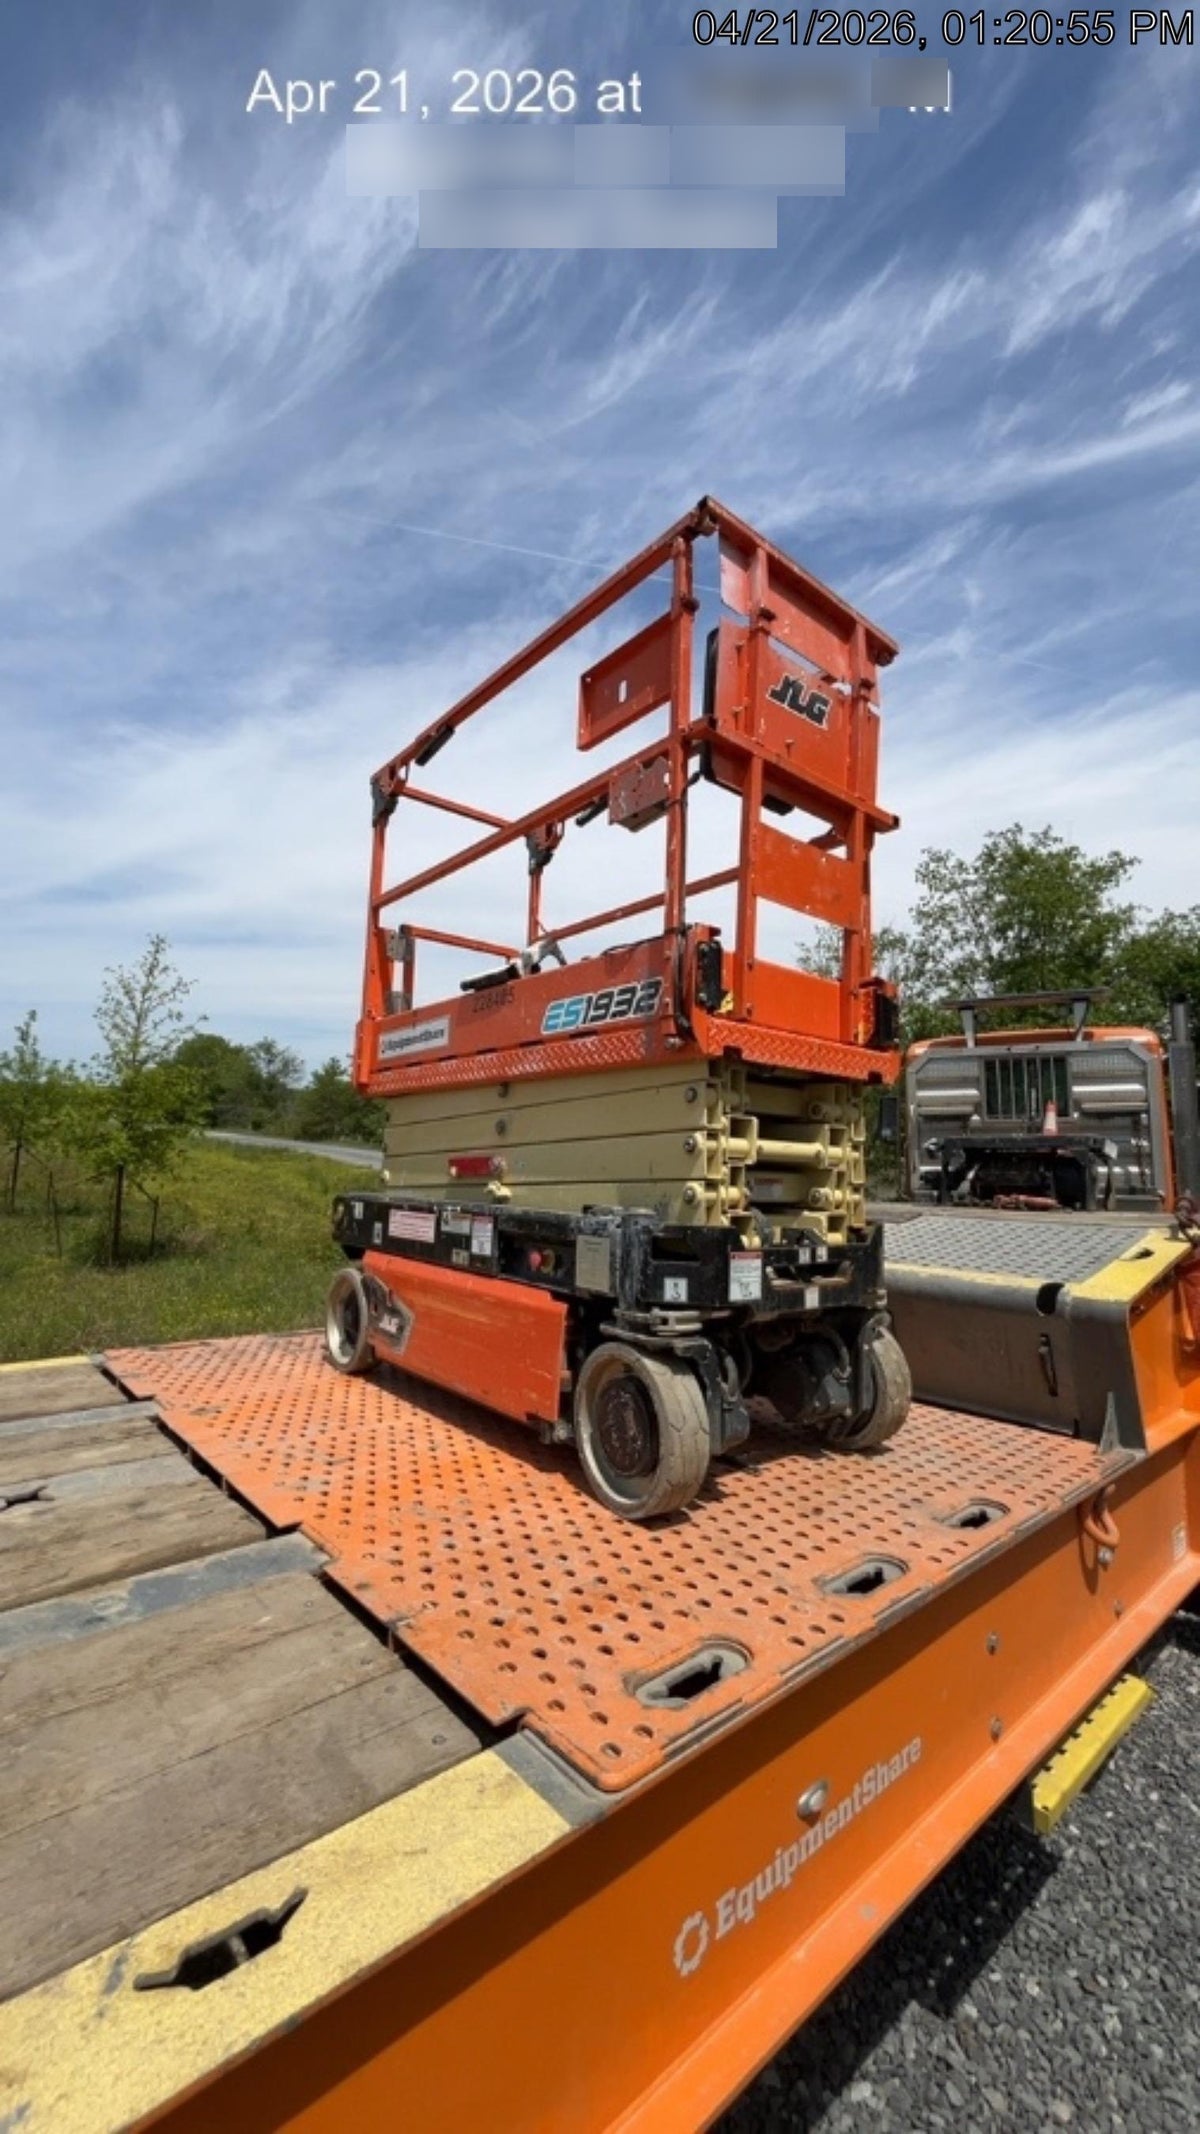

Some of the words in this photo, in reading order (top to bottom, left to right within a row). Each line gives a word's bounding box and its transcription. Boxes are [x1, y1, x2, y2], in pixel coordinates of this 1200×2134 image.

[768, 674, 831, 728] JLG
[543, 978, 663, 1032] ES1932
[715, 1736, 922, 1940] EquipmentShare
